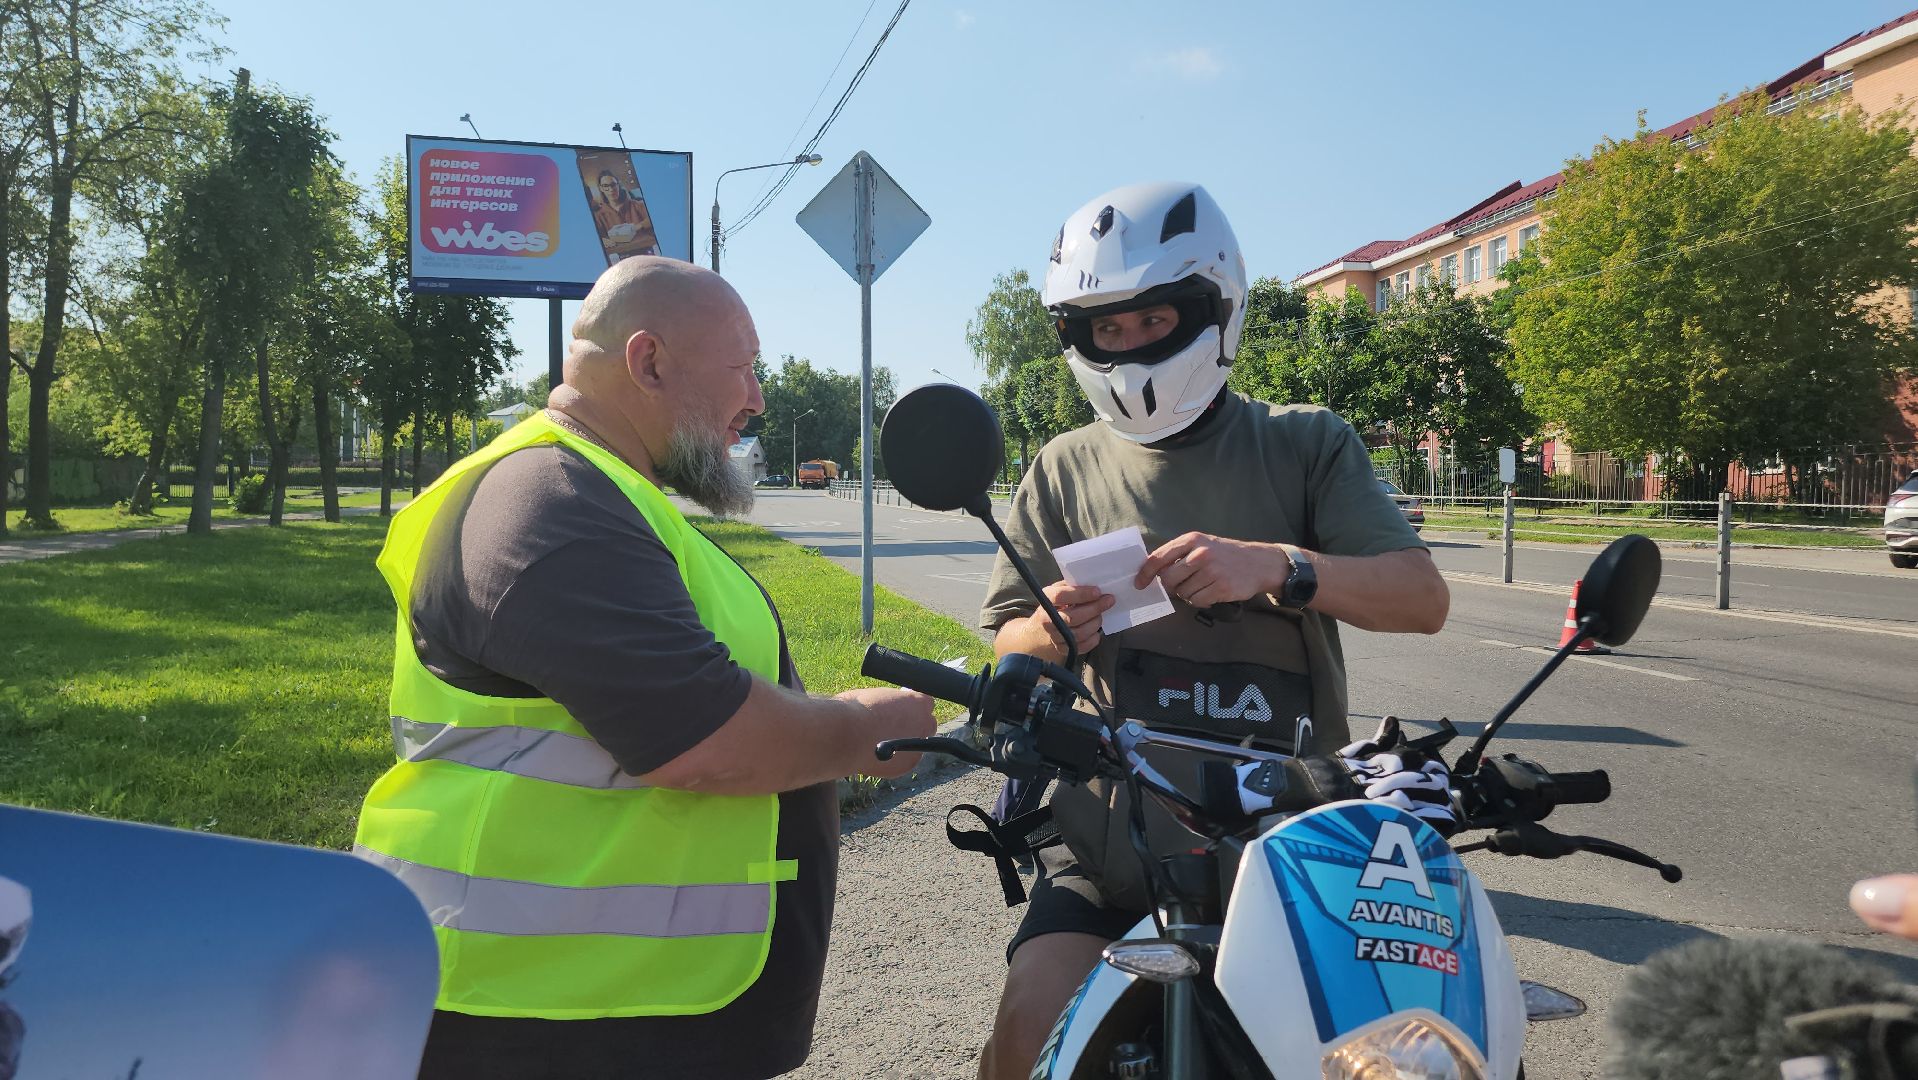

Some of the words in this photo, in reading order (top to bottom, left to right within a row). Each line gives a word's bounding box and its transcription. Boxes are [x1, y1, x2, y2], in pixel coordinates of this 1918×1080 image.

[430, 159, 480, 170] новое
[430, 172, 536, 187] приложение
[429, 185, 461, 196] для
[465, 187, 513, 198] твоих
[430, 199, 519, 212] интересов
[430, 220, 550, 252] wibes
[1158, 679, 1273, 722] FILA
[1358, 820, 1435, 900] A
[1349, 900, 1455, 939] AVANTIS
[1356, 938, 1458, 974] FASTACE
